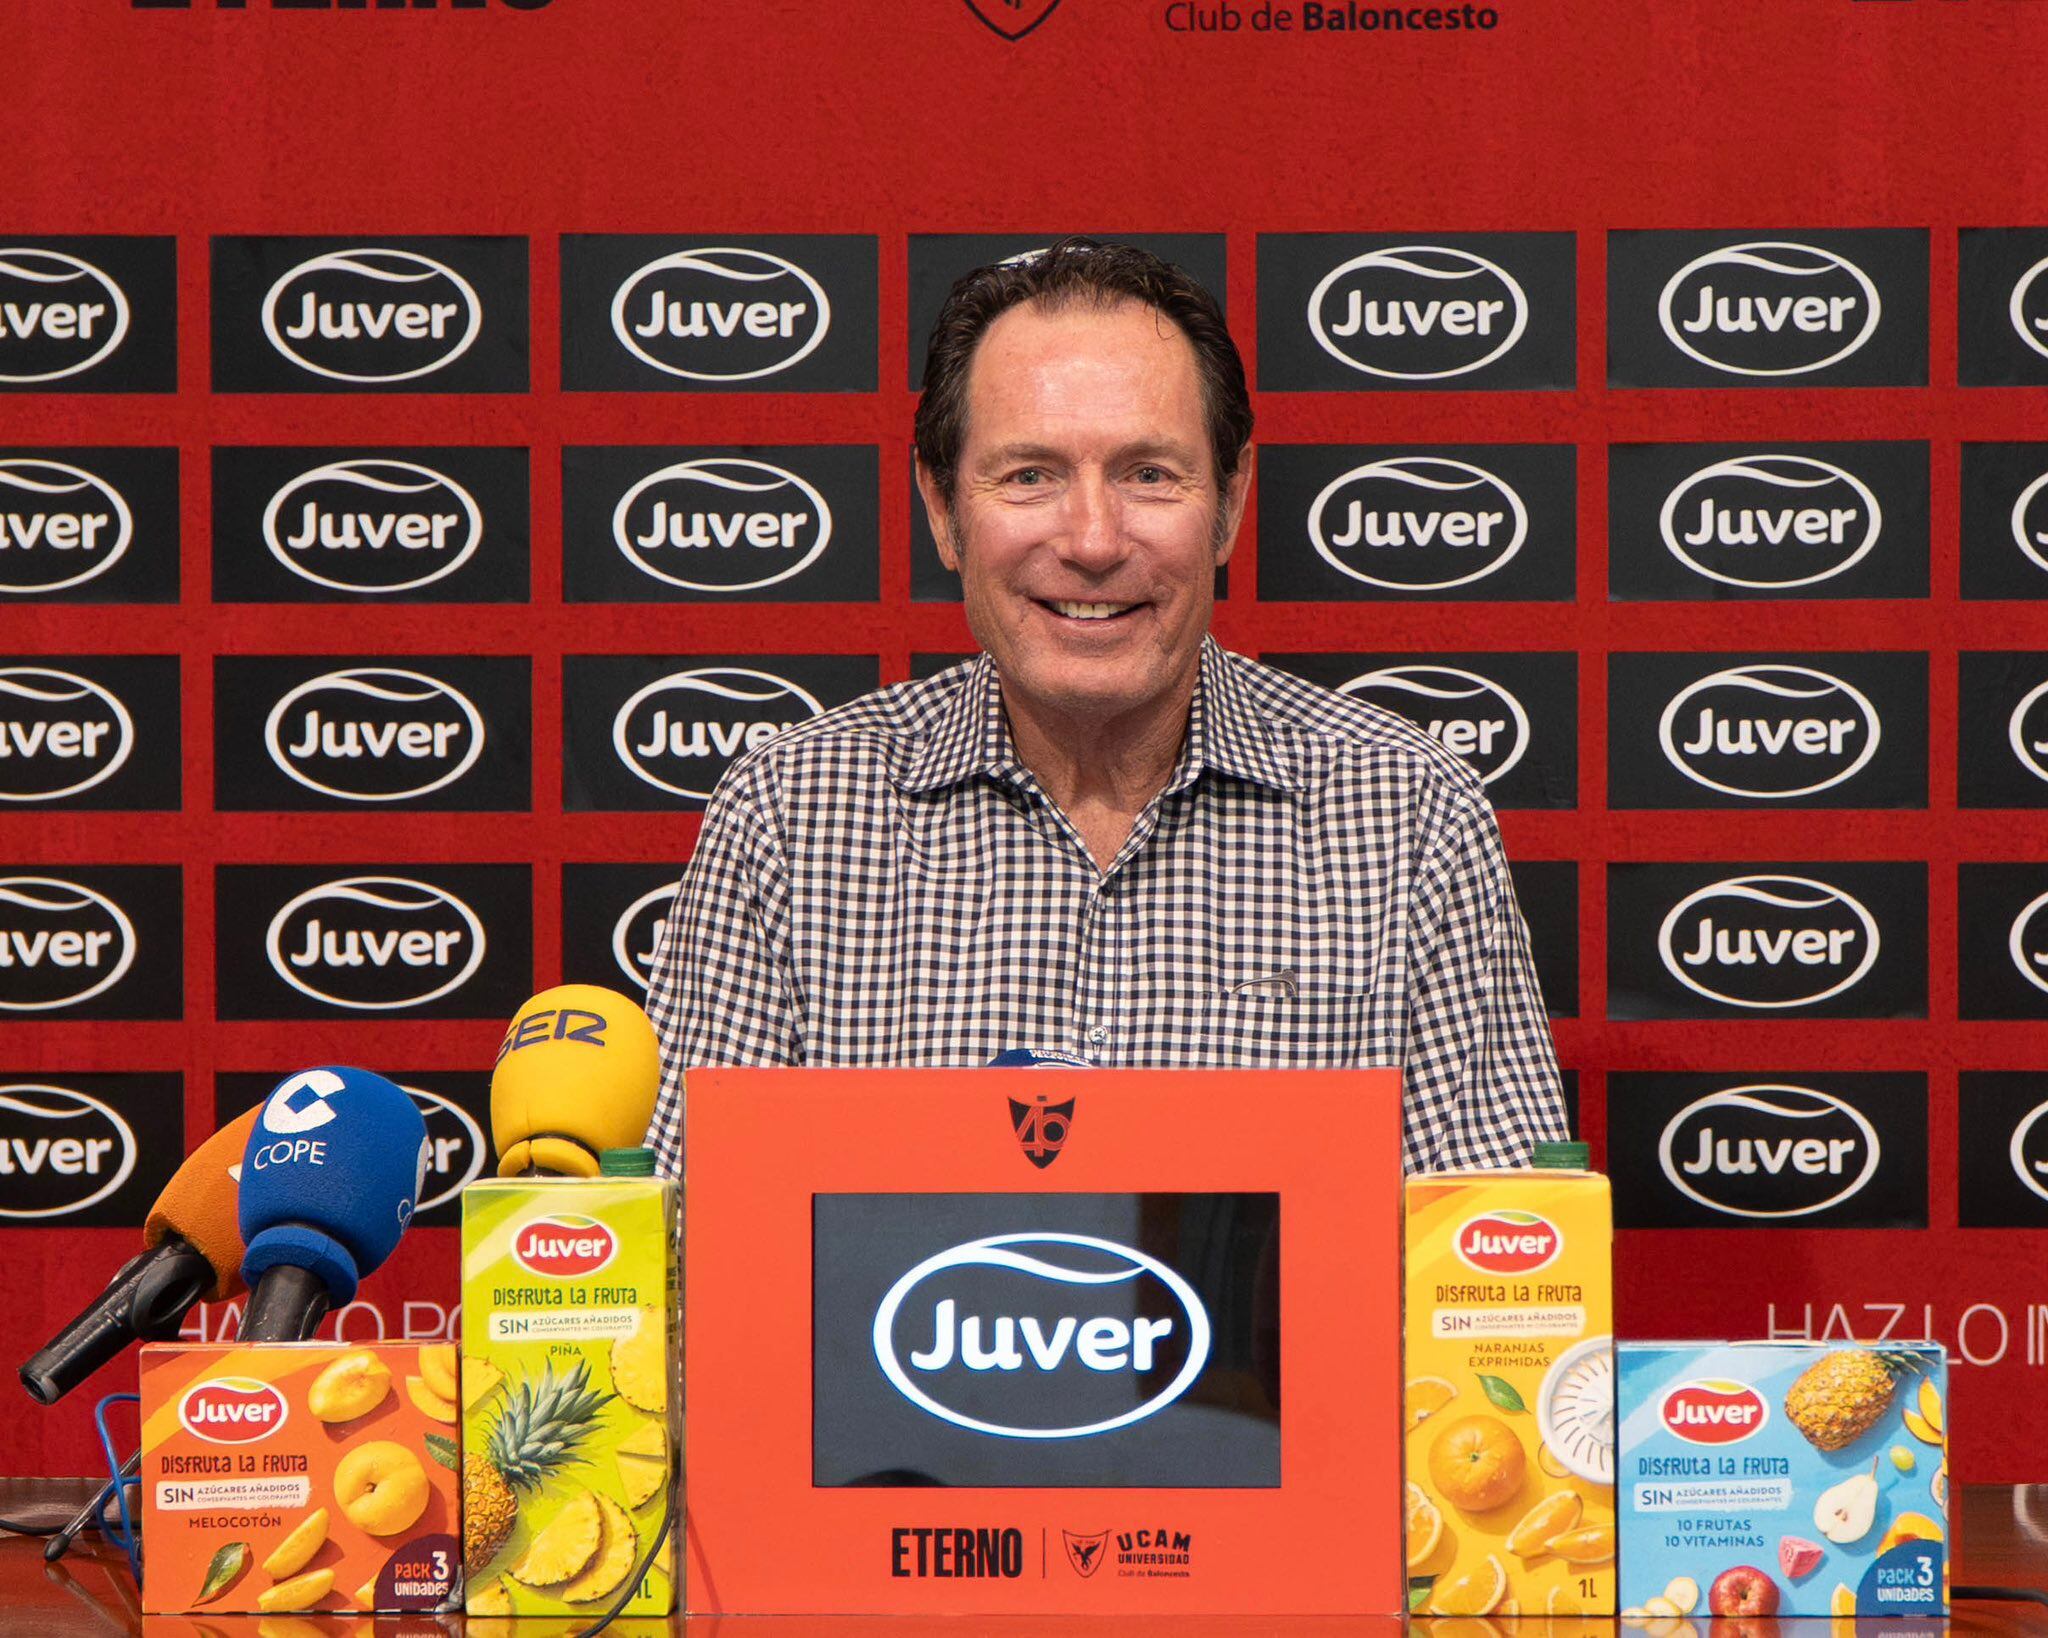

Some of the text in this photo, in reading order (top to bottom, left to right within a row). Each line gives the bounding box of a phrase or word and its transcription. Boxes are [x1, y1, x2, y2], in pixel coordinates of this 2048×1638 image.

[1165, 2, 1499, 32] Club de Baloncesto
[286, 292, 457, 338] Juver
[635, 290, 806, 337] Juver
[1331, 289, 1504, 336] Juver
[1683, 285, 1856, 332] Juver
[287, 502, 458, 548] Juver
[637, 501, 808, 548] Juver
[1332, 500, 1504, 546] Juver
[1684, 498, 1857, 545] Juver
[289, 710, 460, 757] Juver
[637, 710, 793, 757] Juve
[1683, 708, 1856, 755] Juver
[290, 919, 461, 966] Juver
[1683, 918, 1855, 965] Juver
[254, 1139, 328, 1171] COPE
[1683, 1128, 1856, 1174] Juver
[521, 1233, 607, 1259] Juver
[1465, 1229, 1552, 1255] Juver
[499, 1319, 529, 1334] SIN
[532, 1314, 633, 1326] AZÚCARES AÑADIDOS
[1441, 1316, 1472, 1331] SIN
[911, 1299, 1173, 1371] Juver
[1474, 1343, 1545, 1353] NARANJAS
[550, 1343, 582, 1356] PIÑA
[1469, 1356, 1551, 1368] EXPRIMIDAS
[190, 1398, 277, 1424] Juver
[1668, 1399, 1758, 1425] Juver
[164, 1488, 194, 1503] SIN
[197, 1482, 300, 1495] AZÚCARES AÑADIDOS
[1641, 1490, 1673, 1505] SIN
[1676, 1485, 1782, 1497] AZÚCARES AÑADIDOS
[188, 1512, 283, 1529] MELOCOTÓN
[1677, 1519, 1752, 1531] 10 FRUTAS
[892, 1527, 1022, 1578] ETERNO
[1116, 1529, 1191, 1552] UCAM
[1665, 1535, 1765, 1547] 10 VITAMINAS
[432, 1551, 449, 1581] 3
[1118, 1553, 1190, 1565] UNIVERSIDAD
[1917, 1556, 1934, 1586] 3
[1578, 1579, 1597, 1599] 1L
